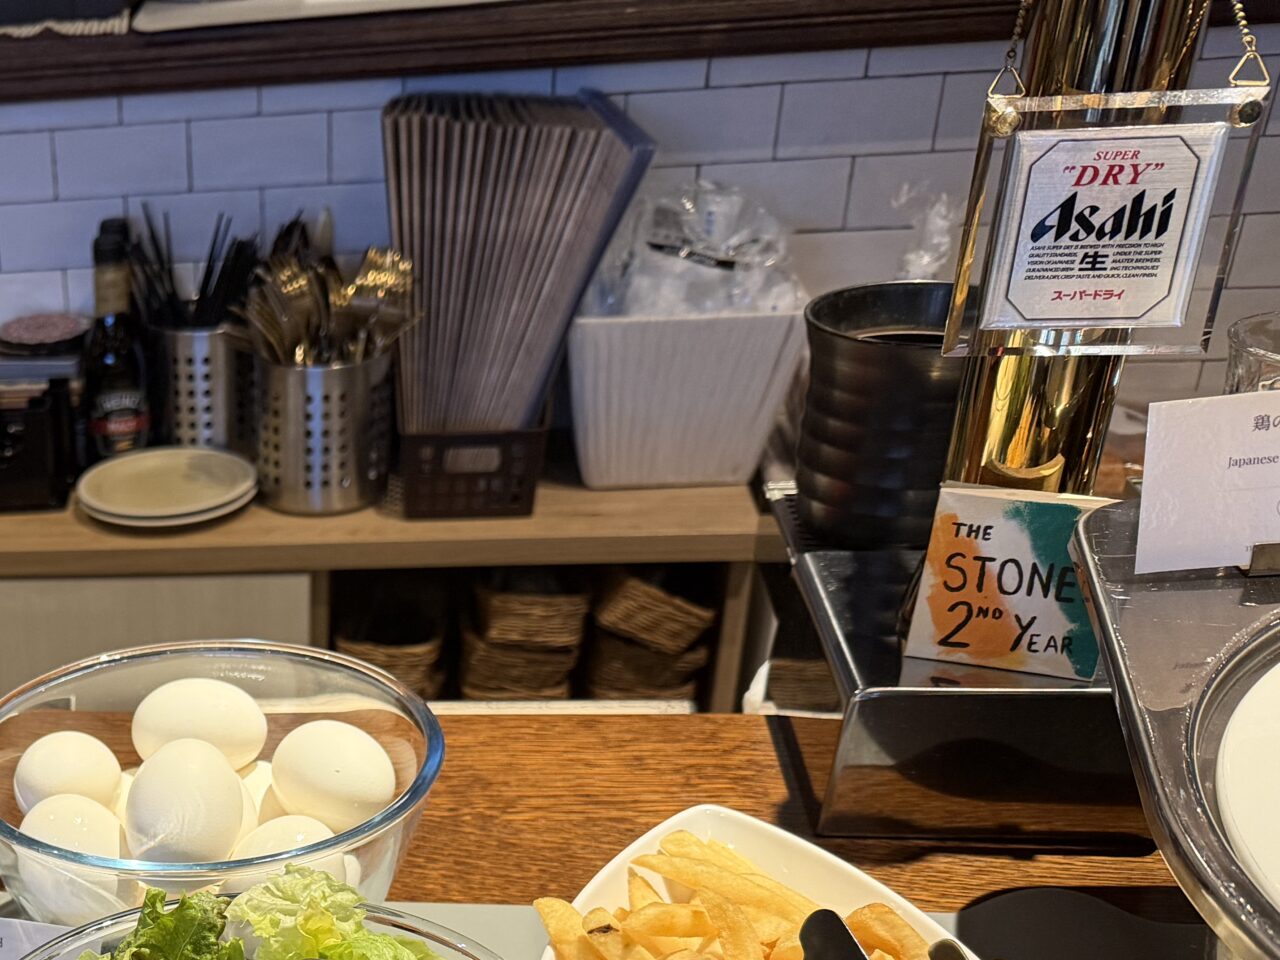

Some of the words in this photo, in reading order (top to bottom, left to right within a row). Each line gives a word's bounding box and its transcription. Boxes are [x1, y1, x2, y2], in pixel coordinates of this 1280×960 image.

[1094, 150, 1141, 161] SUPER
[1031, 187, 1177, 243] Asahi
[1078, 250, 1109, 271] 生
[1051, 289, 1125, 301] スーパードライ
[1227, 455, 1279, 469] Japanese
[952, 521, 994, 541] THE
[943, 552, 1077, 603] STONE
